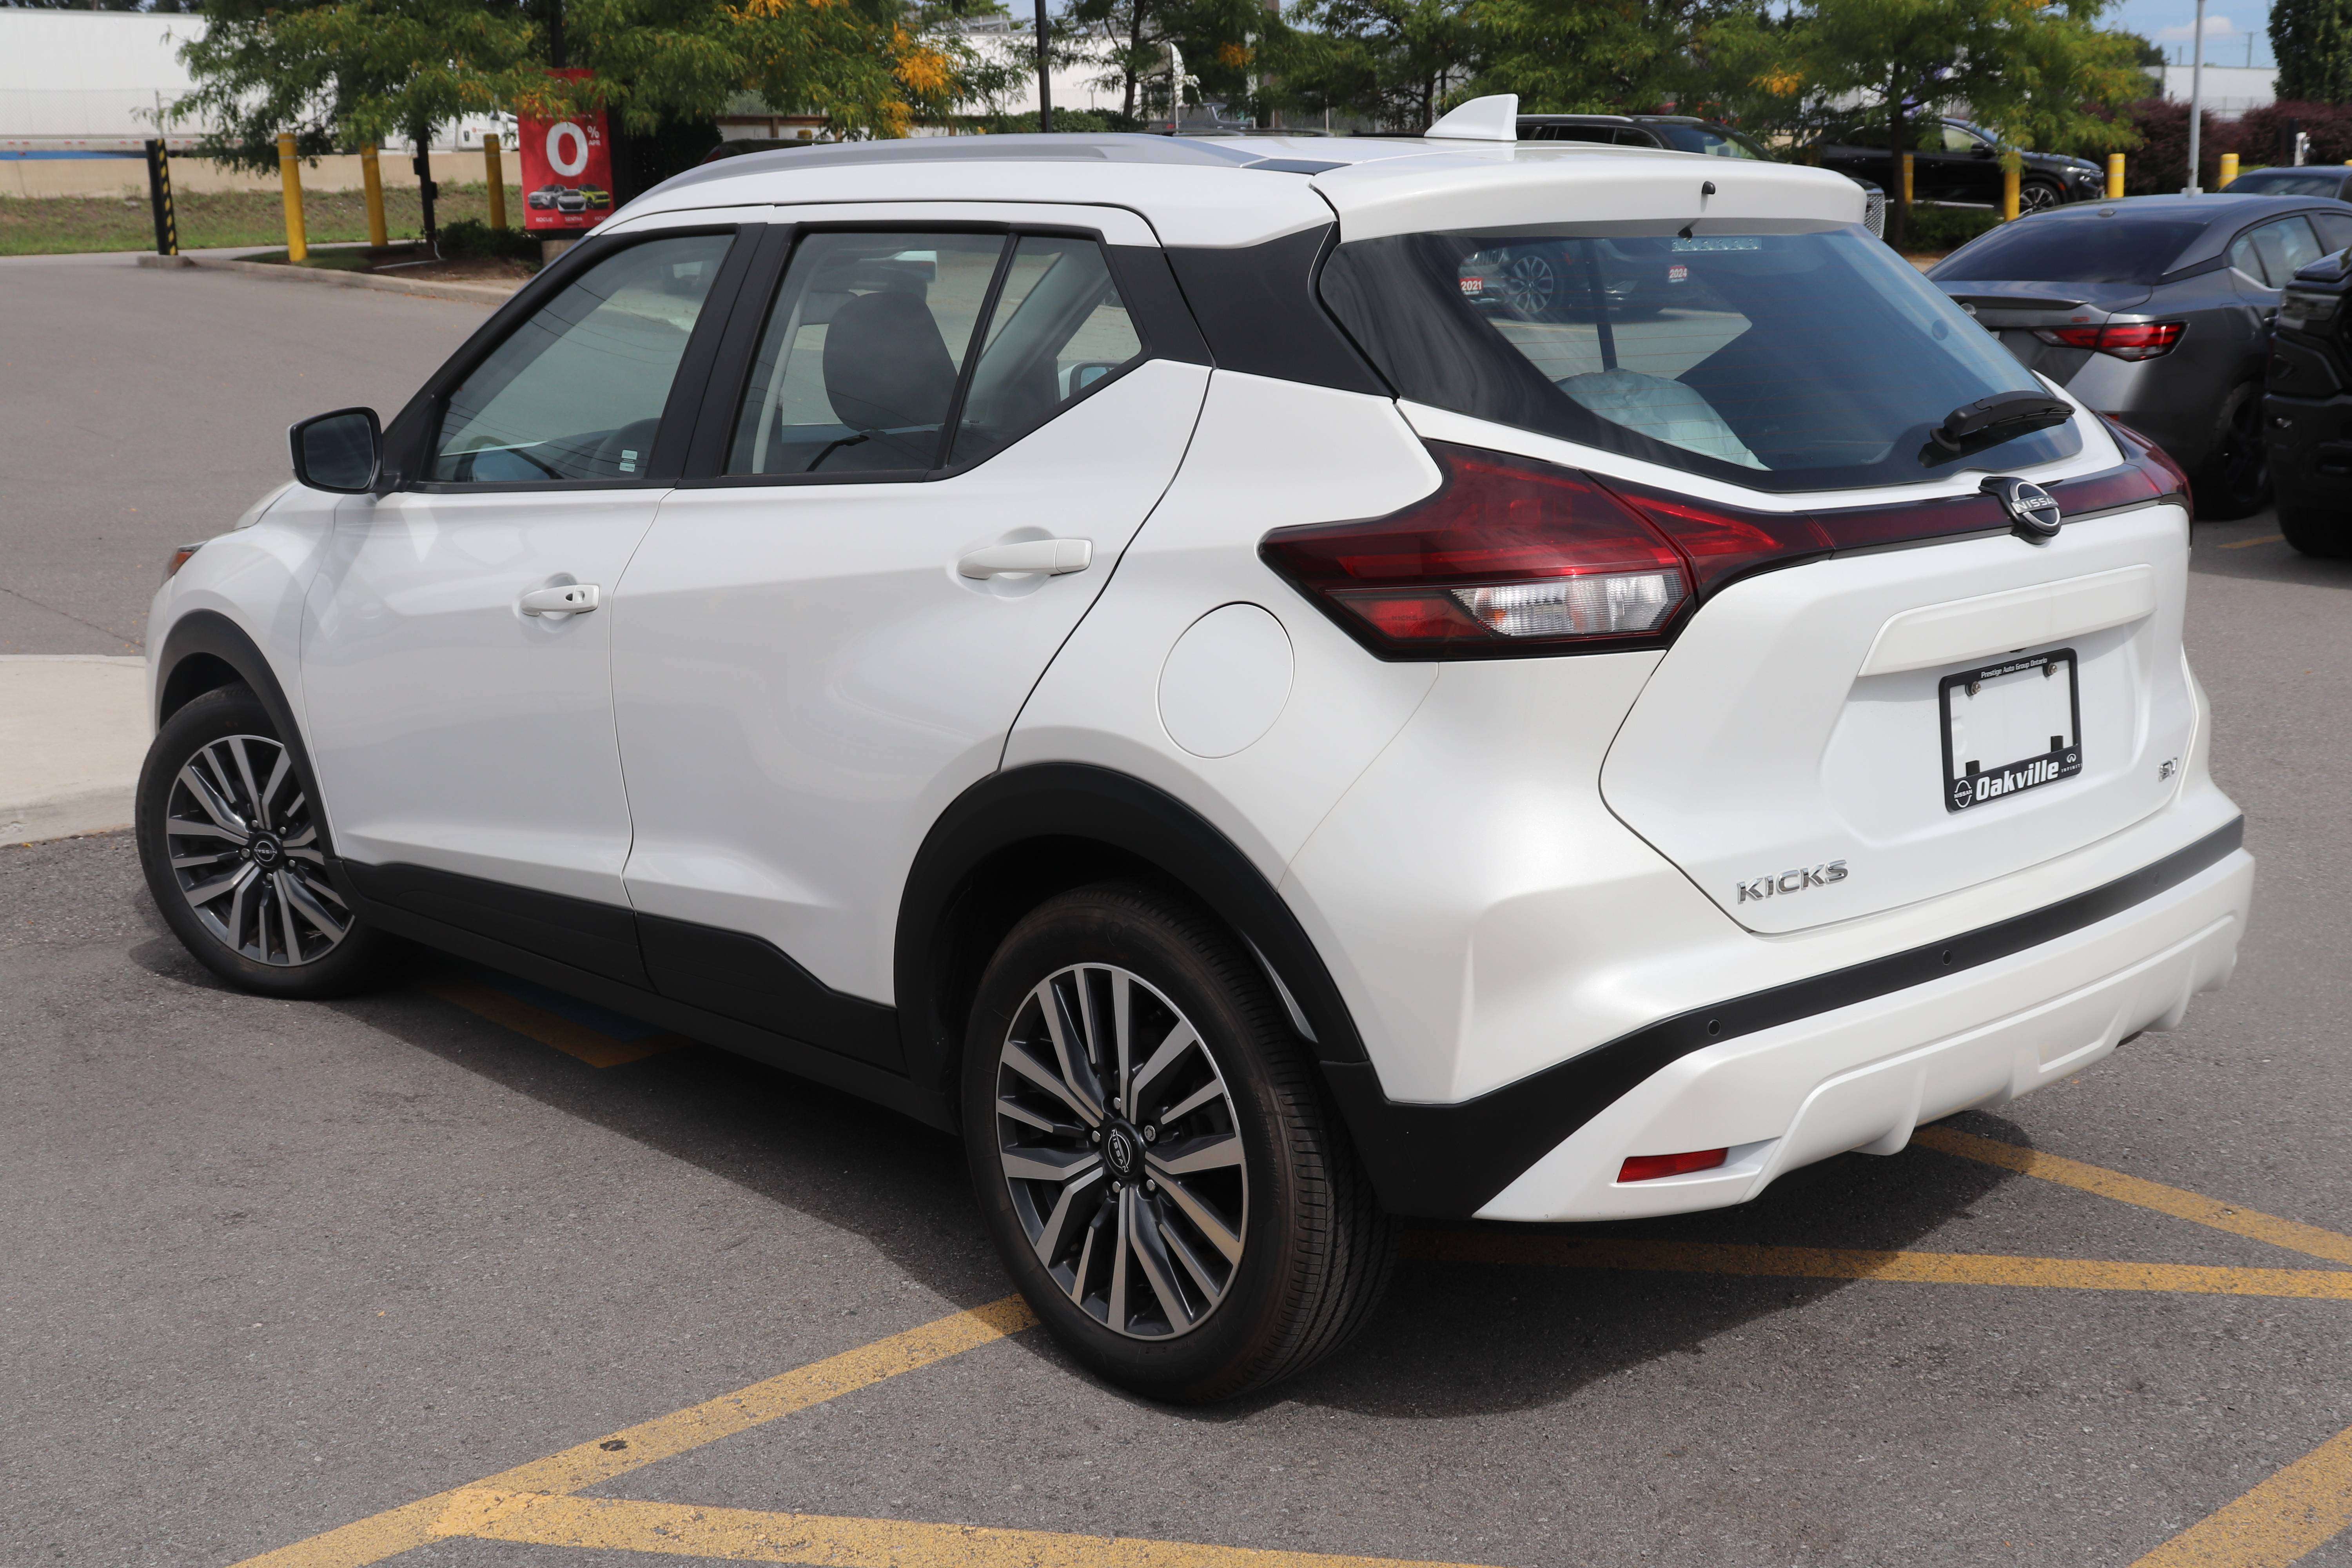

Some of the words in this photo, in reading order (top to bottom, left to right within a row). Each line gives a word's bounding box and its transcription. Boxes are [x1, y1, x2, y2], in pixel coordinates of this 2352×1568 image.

[1669, 268, 1687, 278] 2024
[1461, 280, 1482, 291] 2021
[2014, 495, 2058, 511] NISSAN
[1981, 668, 2002, 679] Prestige
[2003, 664, 2014, 673] Auto
[2015, 662, 2029, 671] Group
[2030, 657, 2047, 666] Ontario
[1975, 759, 2059, 801] Oakville
[1954, 789, 1973, 799] NISSAN
[1737, 858, 1849, 905] KICKS
[1111, 1128, 1129, 1173] NISSAN
